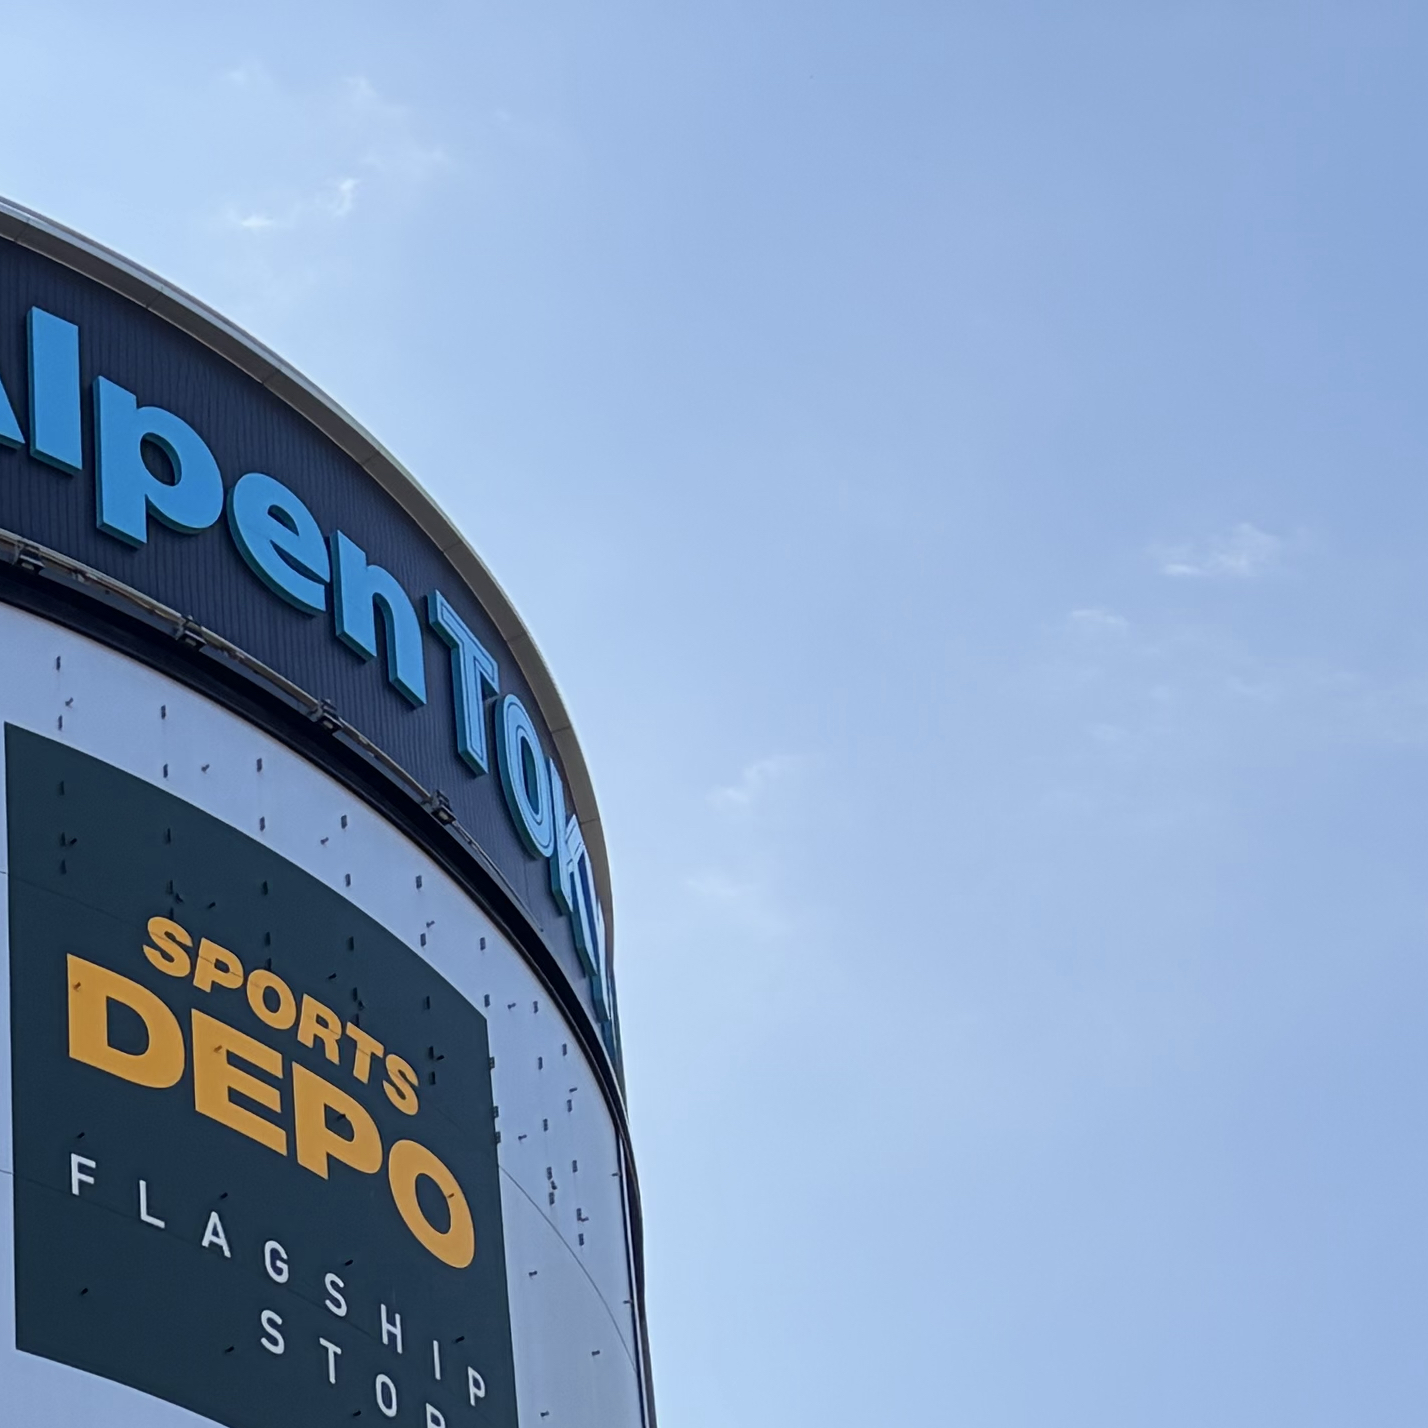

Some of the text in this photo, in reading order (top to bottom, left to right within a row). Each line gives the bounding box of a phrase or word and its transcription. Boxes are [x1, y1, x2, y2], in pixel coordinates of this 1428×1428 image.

[66, 953, 476, 1269] DEPO
[143, 916, 420, 1116] SPORTS
[70, 1152, 486, 1407] FLAGSHIP
